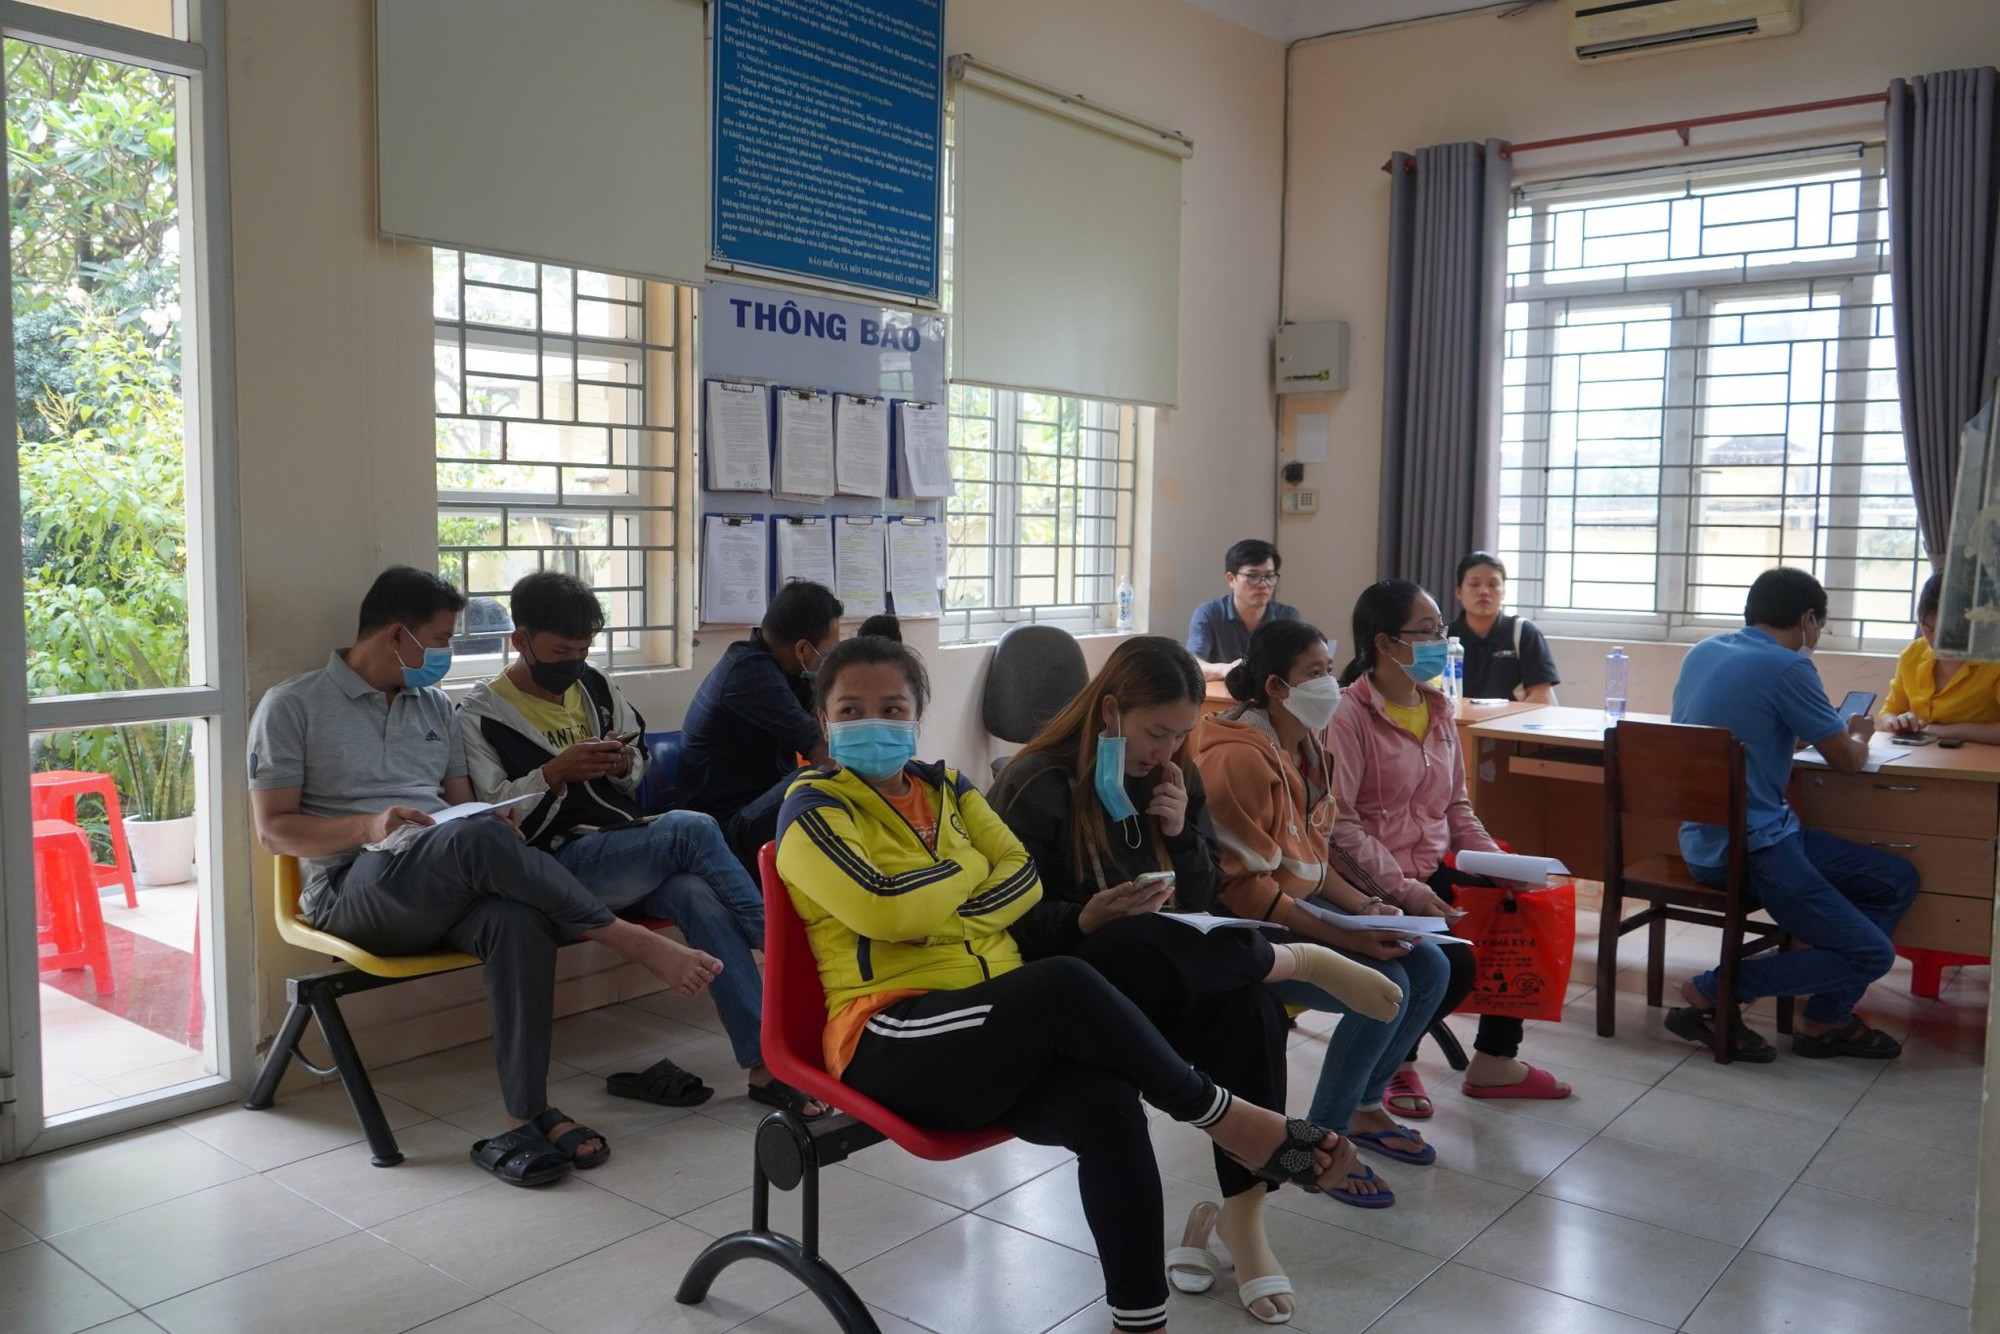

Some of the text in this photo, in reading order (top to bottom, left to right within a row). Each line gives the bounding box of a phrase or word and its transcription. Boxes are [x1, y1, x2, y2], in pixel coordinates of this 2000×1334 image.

[808, 257, 822, 265] BẢO
[822, 259, 839, 269] HIỂM
[840, 263, 848, 271] XÃ
[849, 265, 861, 273] HỘI
[862, 268, 882, 277] THÀNH
[882, 272, 894, 280] PHỐ
[915, 279, 930, 287] MINH
[730, 298, 921, 352] THÔNG BÁO
[542, 727, 576, 748] ANT
